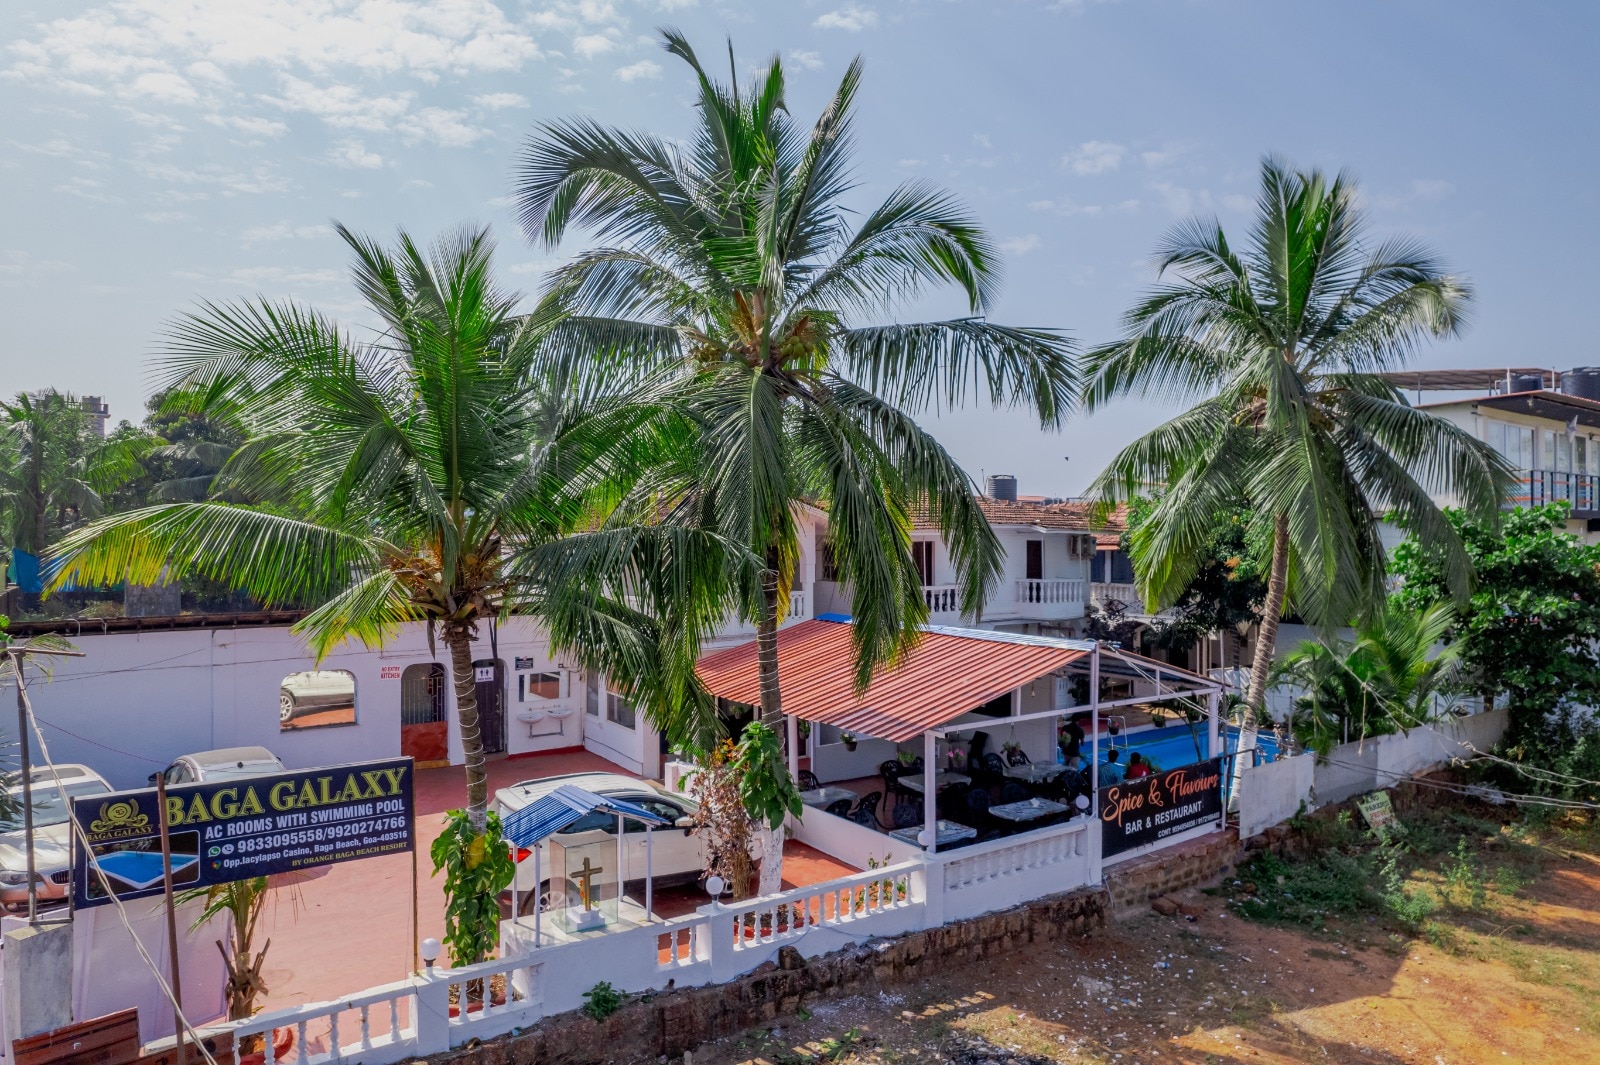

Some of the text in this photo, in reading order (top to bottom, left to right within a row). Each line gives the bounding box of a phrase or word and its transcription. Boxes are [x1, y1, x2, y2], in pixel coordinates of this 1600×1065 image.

[159, 767, 407, 829] BAGA GALAXY
[1103, 787, 1144, 828] Spice
[1148, 779, 1164, 807] &
[1165, 770, 1219, 804] Flavours
[86, 826, 153, 842] BAGA GALAXY
[205, 799, 405, 840] AC ROOMS WITH SWIMMING POOL
[237, 816, 406, 853] 9833095558/9920274766
[1125, 822, 1143, 835] BAR
[1145, 816, 1152, 828] &
[1154, 801, 1203, 826] RESTAURANT
[283, 847, 313, 858] Casino,
[314, 843, 334, 853] Baga
[336, 838, 361, 849] Beach,
[363, 831, 408, 845] Goa-403516
[292, 842, 408, 867] BY ORANGE BAGA BEACH RESORT
